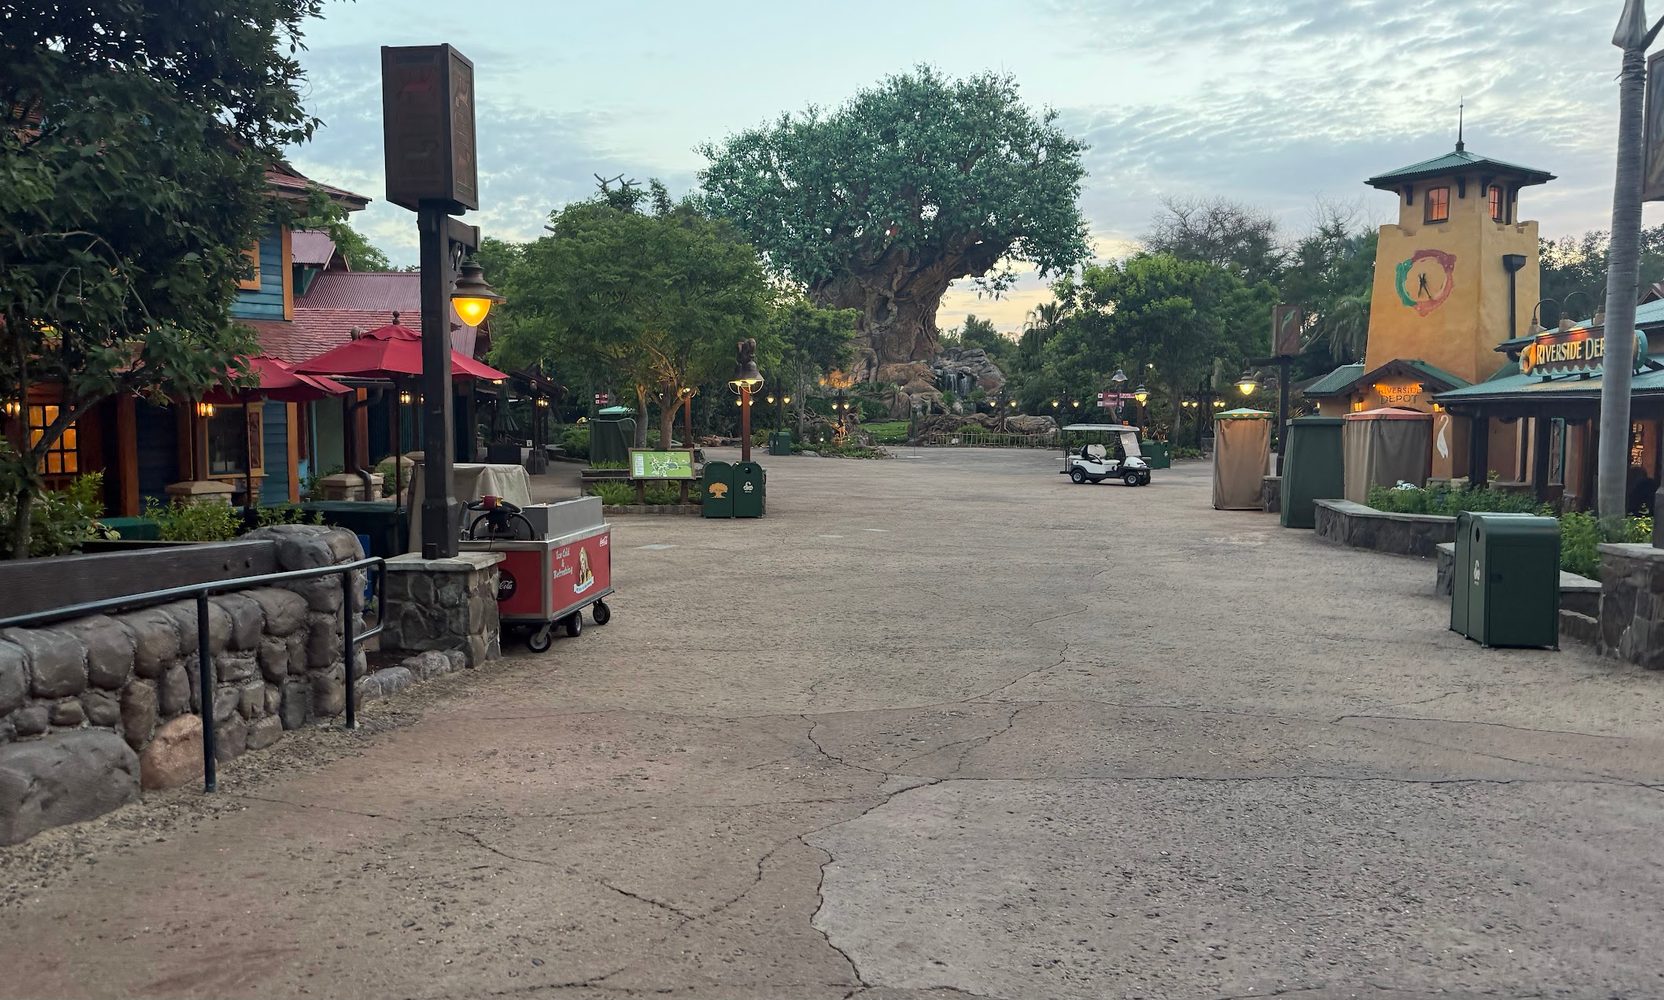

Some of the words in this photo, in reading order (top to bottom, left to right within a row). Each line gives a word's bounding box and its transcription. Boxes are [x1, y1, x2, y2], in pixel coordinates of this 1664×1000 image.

[1536, 340, 1582, 365] RIVERSIDE
[1585, 337, 1605, 360] DEP
[1378, 386, 1422, 395] RIVERSIDE
[1380, 395, 1418, 404] DEPOT
